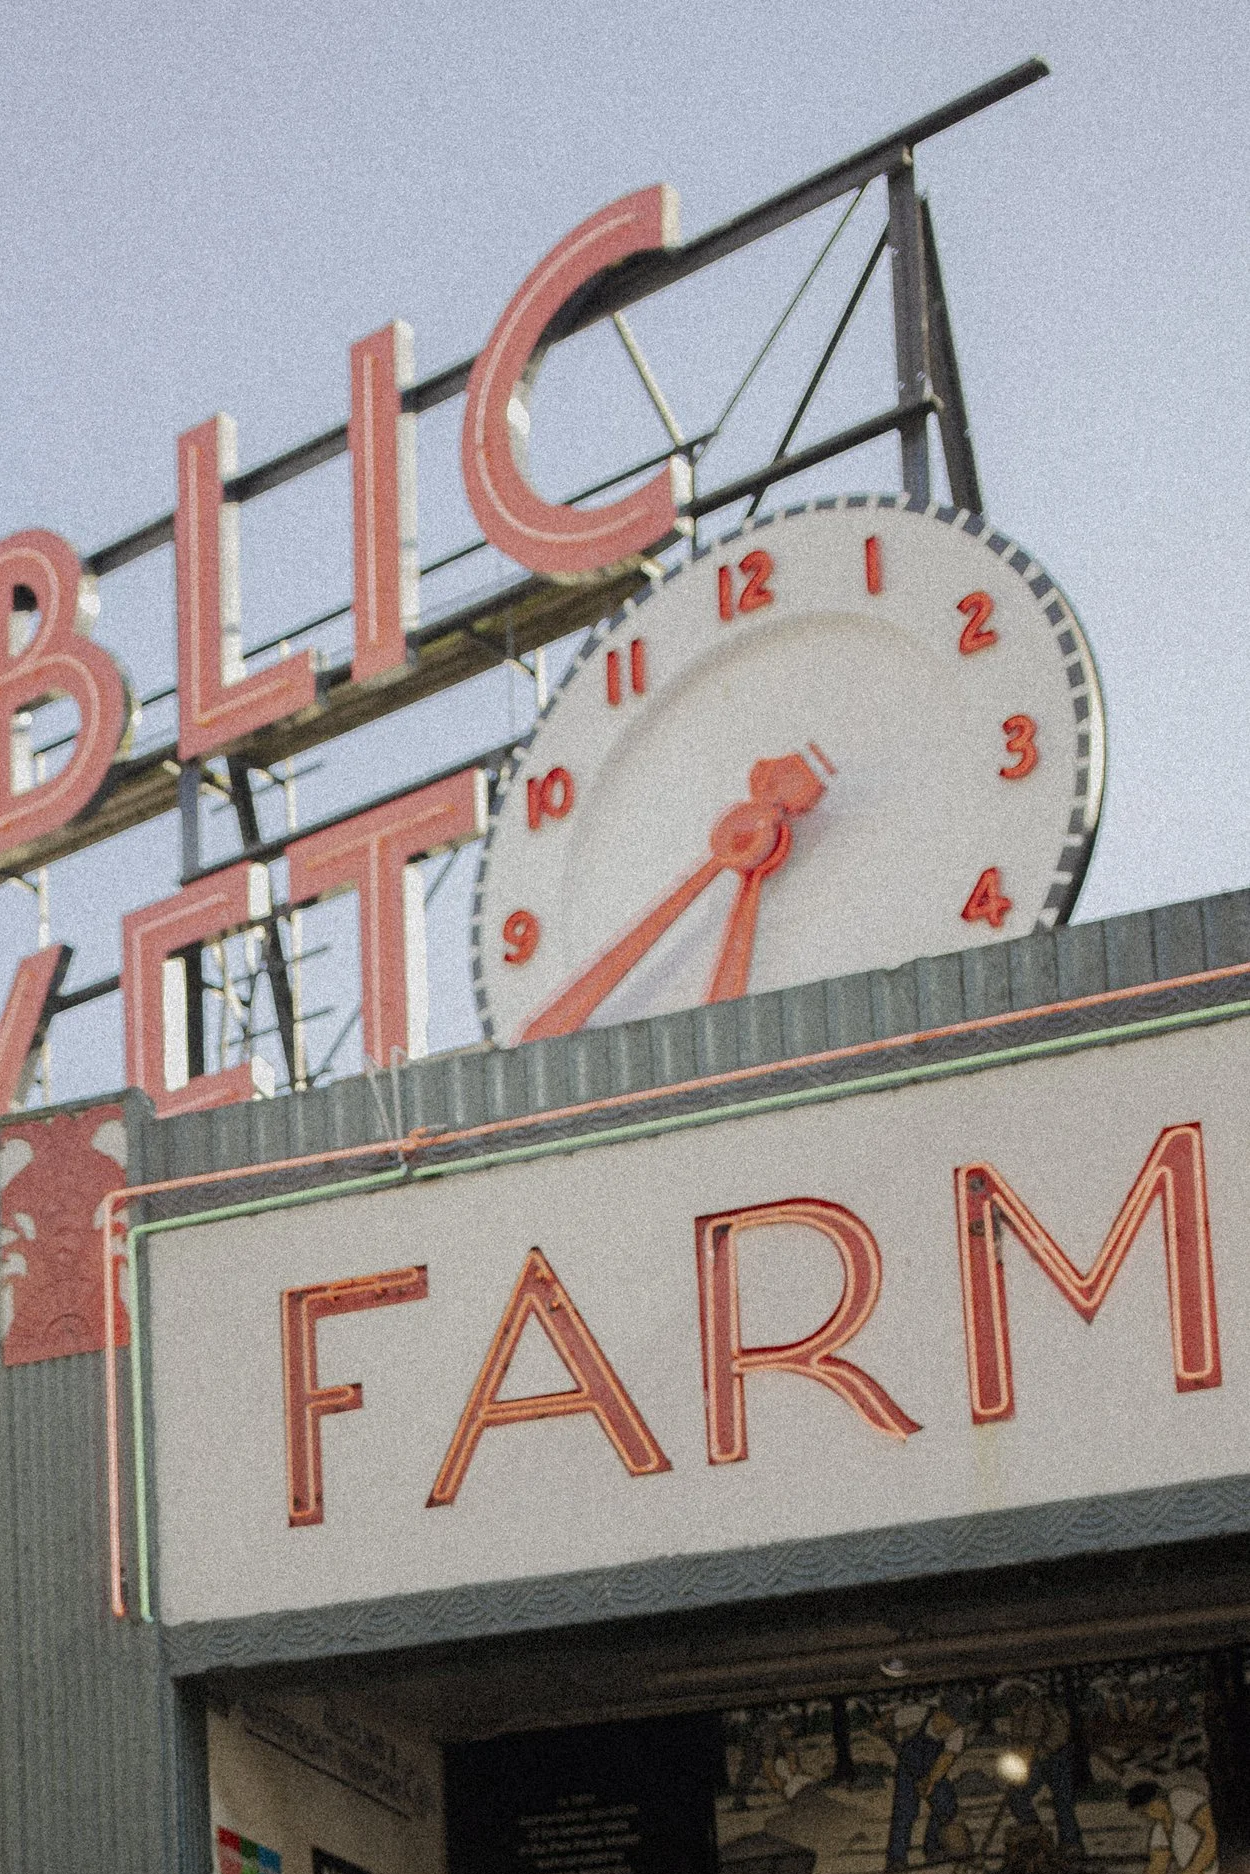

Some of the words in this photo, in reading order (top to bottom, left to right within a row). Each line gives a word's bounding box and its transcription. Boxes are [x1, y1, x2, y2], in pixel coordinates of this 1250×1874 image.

[718, 550, 774, 621] 12
[865, 535, 883, 595] 1
[956, 591, 997, 655] 2
[607, 639, 645, 706] 11
[999, 714, 1039, 780] 3
[527, 766, 575, 830] 10
[961, 866, 1012, 928] 4
[503, 910, 540, 965] 9
[280, 1121, 1223, 1526] FARM
